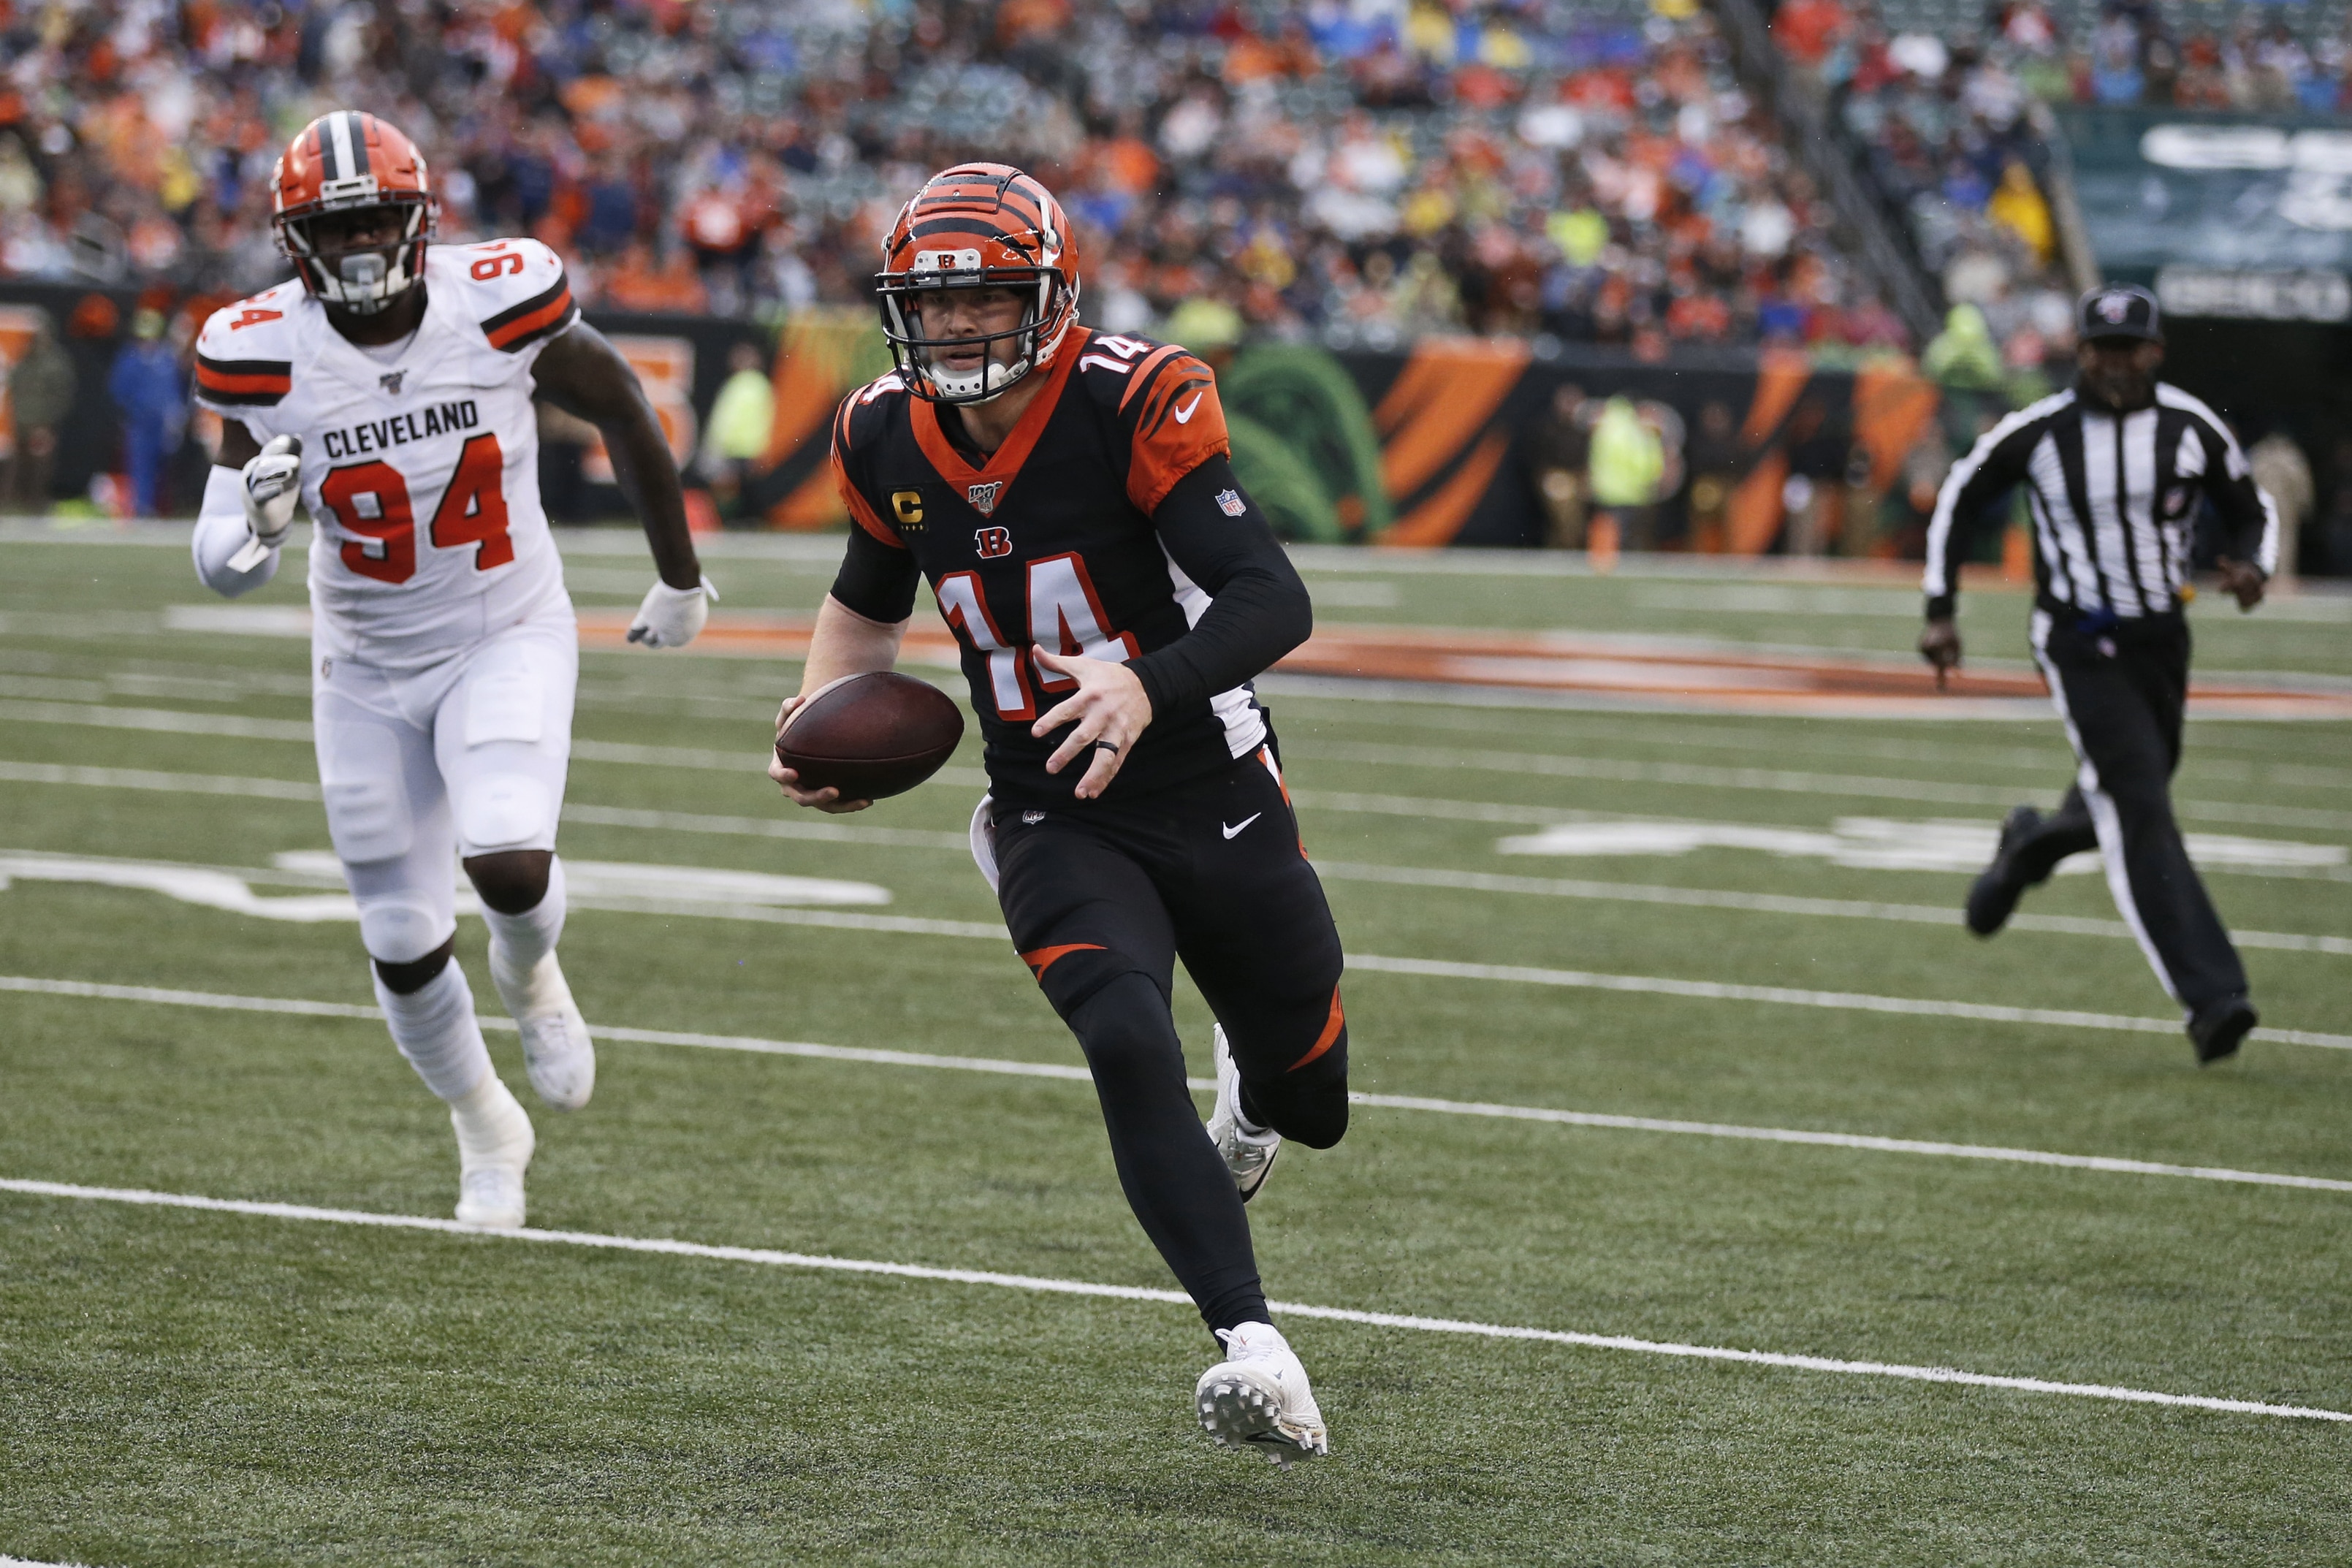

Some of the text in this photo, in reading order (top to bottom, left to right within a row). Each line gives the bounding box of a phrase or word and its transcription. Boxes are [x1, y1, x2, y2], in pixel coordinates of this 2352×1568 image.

[227, 292, 283, 331] 4
[1079, 335, 1154, 374] 14
[323, 400, 478, 458] CLEVELAND
[320, 431, 514, 586] 94
[891, 491, 923, 523] C
[974, 526, 1013, 559] B
[935, 550, 1143, 722] 14
